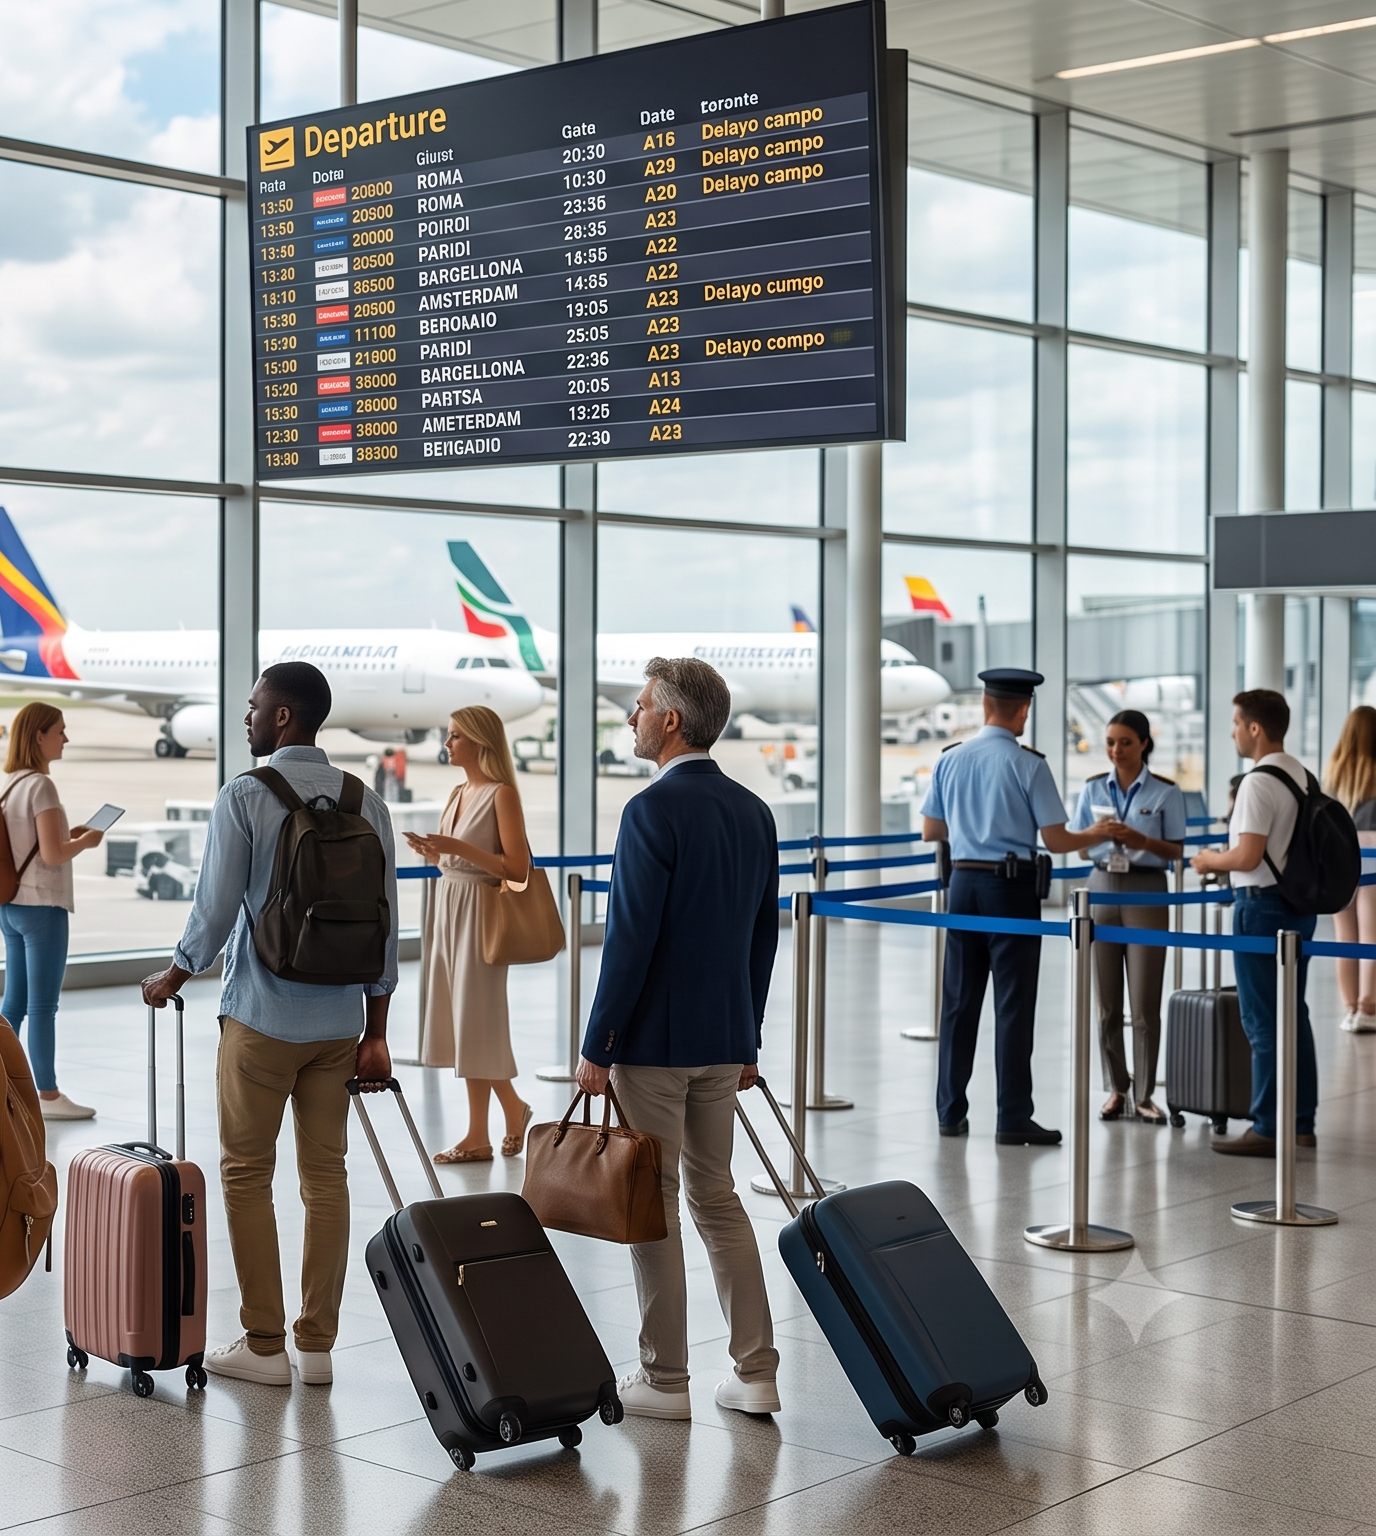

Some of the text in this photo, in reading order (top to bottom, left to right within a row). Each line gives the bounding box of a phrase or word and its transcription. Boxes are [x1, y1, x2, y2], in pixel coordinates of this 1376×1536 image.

[259, 180, 286, 193] Rata
[640, 109, 675, 125] Date
[305, 108, 447, 158] Departure
[260, 199, 294, 214] 13:50
[417, 169, 464, 189] ROMA
[562, 144, 605, 163] 20:30
[643, 132, 675, 150] A16
[702, 120, 759, 139] Delayo
[764, 108, 823, 128] campo
[261, 221, 294, 237] 13:50
[417, 193, 464, 213] ROMA
[563, 170, 606, 189] 10:30
[644, 158, 676, 176] A29
[702, 147, 759, 166] Delayo
[764, 136, 824, 156] campo
[352, 229, 394, 246] 20000
[418, 216, 470, 237] POIROI
[644, 184, 677, 202] A20
[703, 174, 759, 193] Delayo
[764, 164, 824, 183] campo
[352, 252, 394, 270] 20500
[418, 241, 471, 262] PARIDI
[644, 211, 676, 228] A23
[418, 258, 524, 287] BARGELLONA
[645, 237, 677, 255] A22
[262, 313, 297, 328] 15:30
[418, 284, 518, 311] AMSTERDAM
[645, 263, 678, 281] A22
[355, 325, 396, 341] 11100
[566, 300, 608, 317] 19:05
[646, 290, 679, 308] A23
[704, 284, 762, 301] Delayo
[420, 340, 471, 359] PARIDI
[566, 326, 609, 343] 25:05
[646, 317, 680, 334] A23
[420, 359, 526, 384] BARGELLONA
[567, 351, 609, 368] 22:36
[647, 344, 680, 361] A23
[766, 333, 825, 350] compo
[568, 378, 610, 394] 20:05
[648, 371, 681, 387] A13
[265, 429, 299, 443] 12:30
[356, 421, 398, 436] 38000
[422, 411, 521, 433] AMETERDAM
[648, 398, 681, 414] A24
[356, 446, 398, 460] 38300
[567, 431, 611, 447] 22:30
[649, 424, 682, 441] A23
